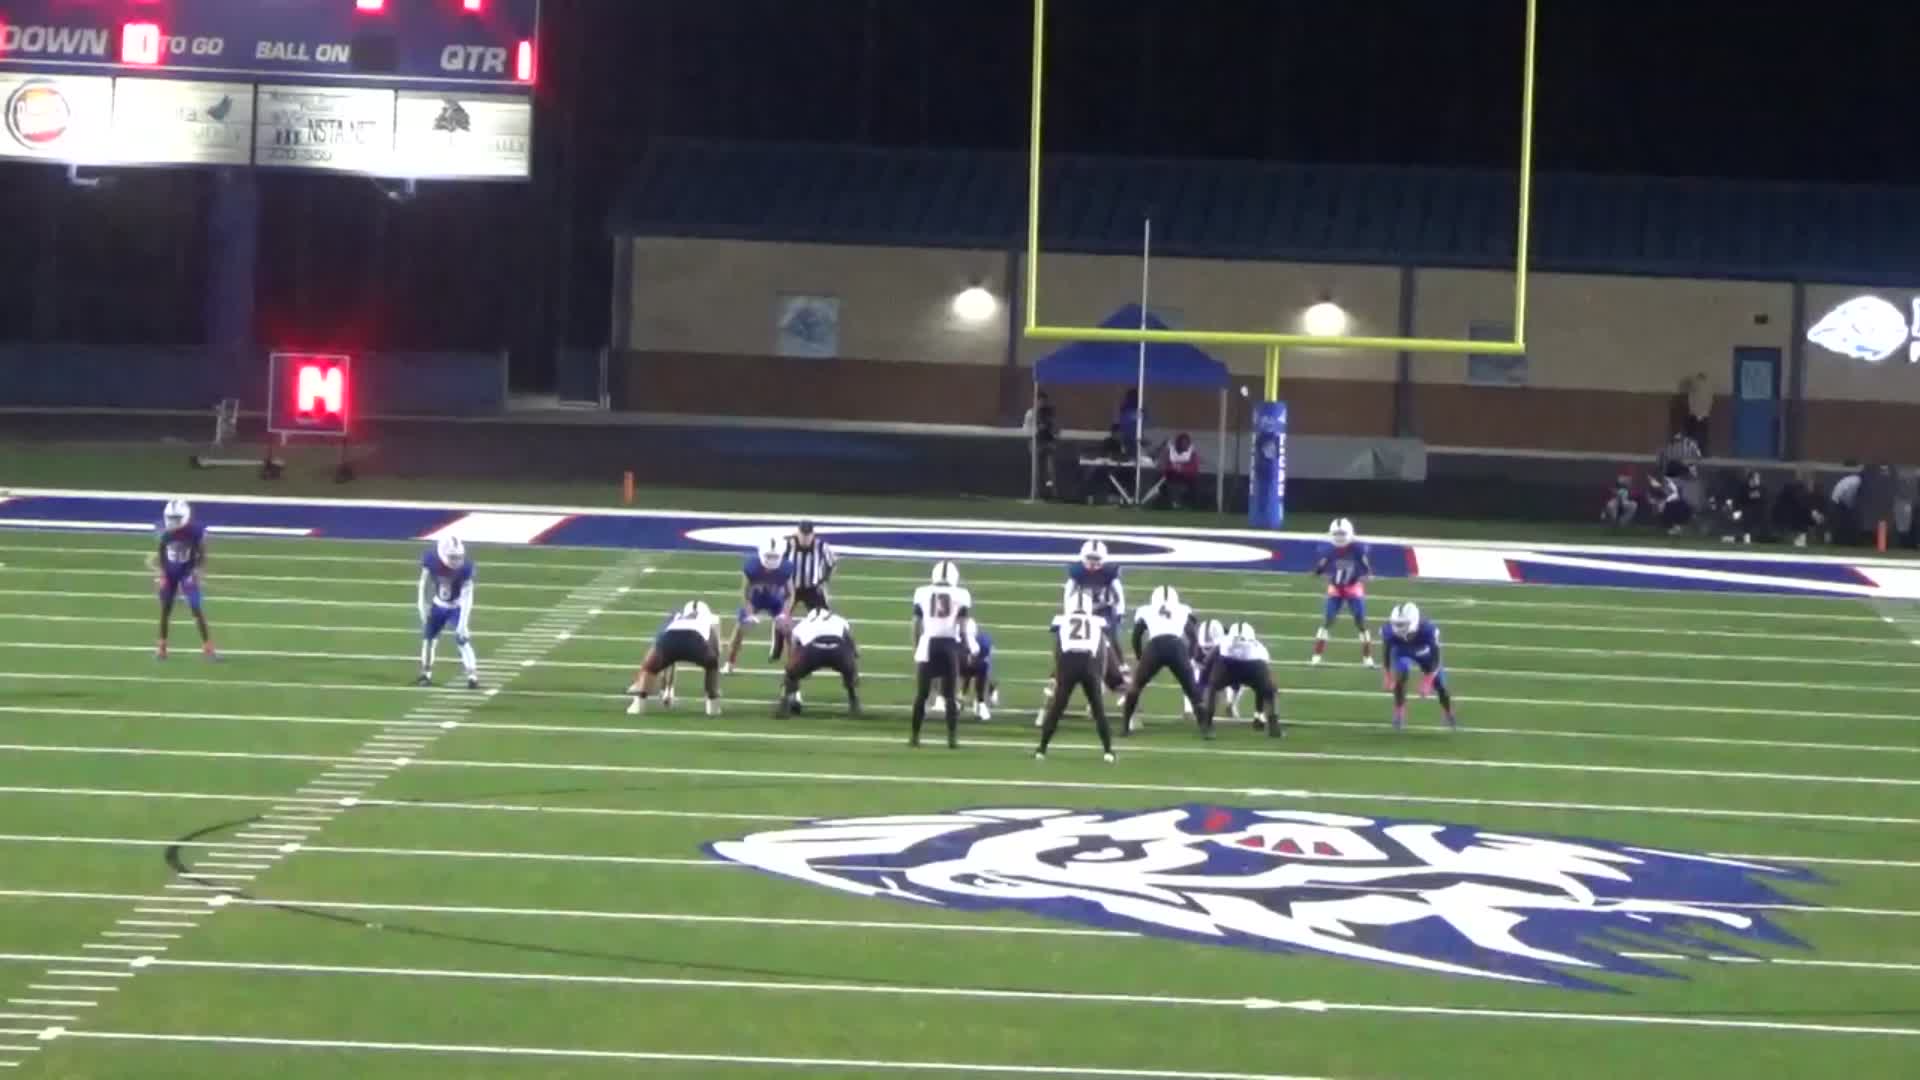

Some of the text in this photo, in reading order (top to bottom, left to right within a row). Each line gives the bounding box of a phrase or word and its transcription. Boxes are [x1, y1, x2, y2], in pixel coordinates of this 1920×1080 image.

[2, 26, 109, 55] DOWN
[159, 35, 224, 55] TO GO
[255, 41, 350, 63] BALL ON
[440, 44, 508, 73] QTR
[929, 592, 952, 619] 13
[1068, 617, 1092, 640] 21
